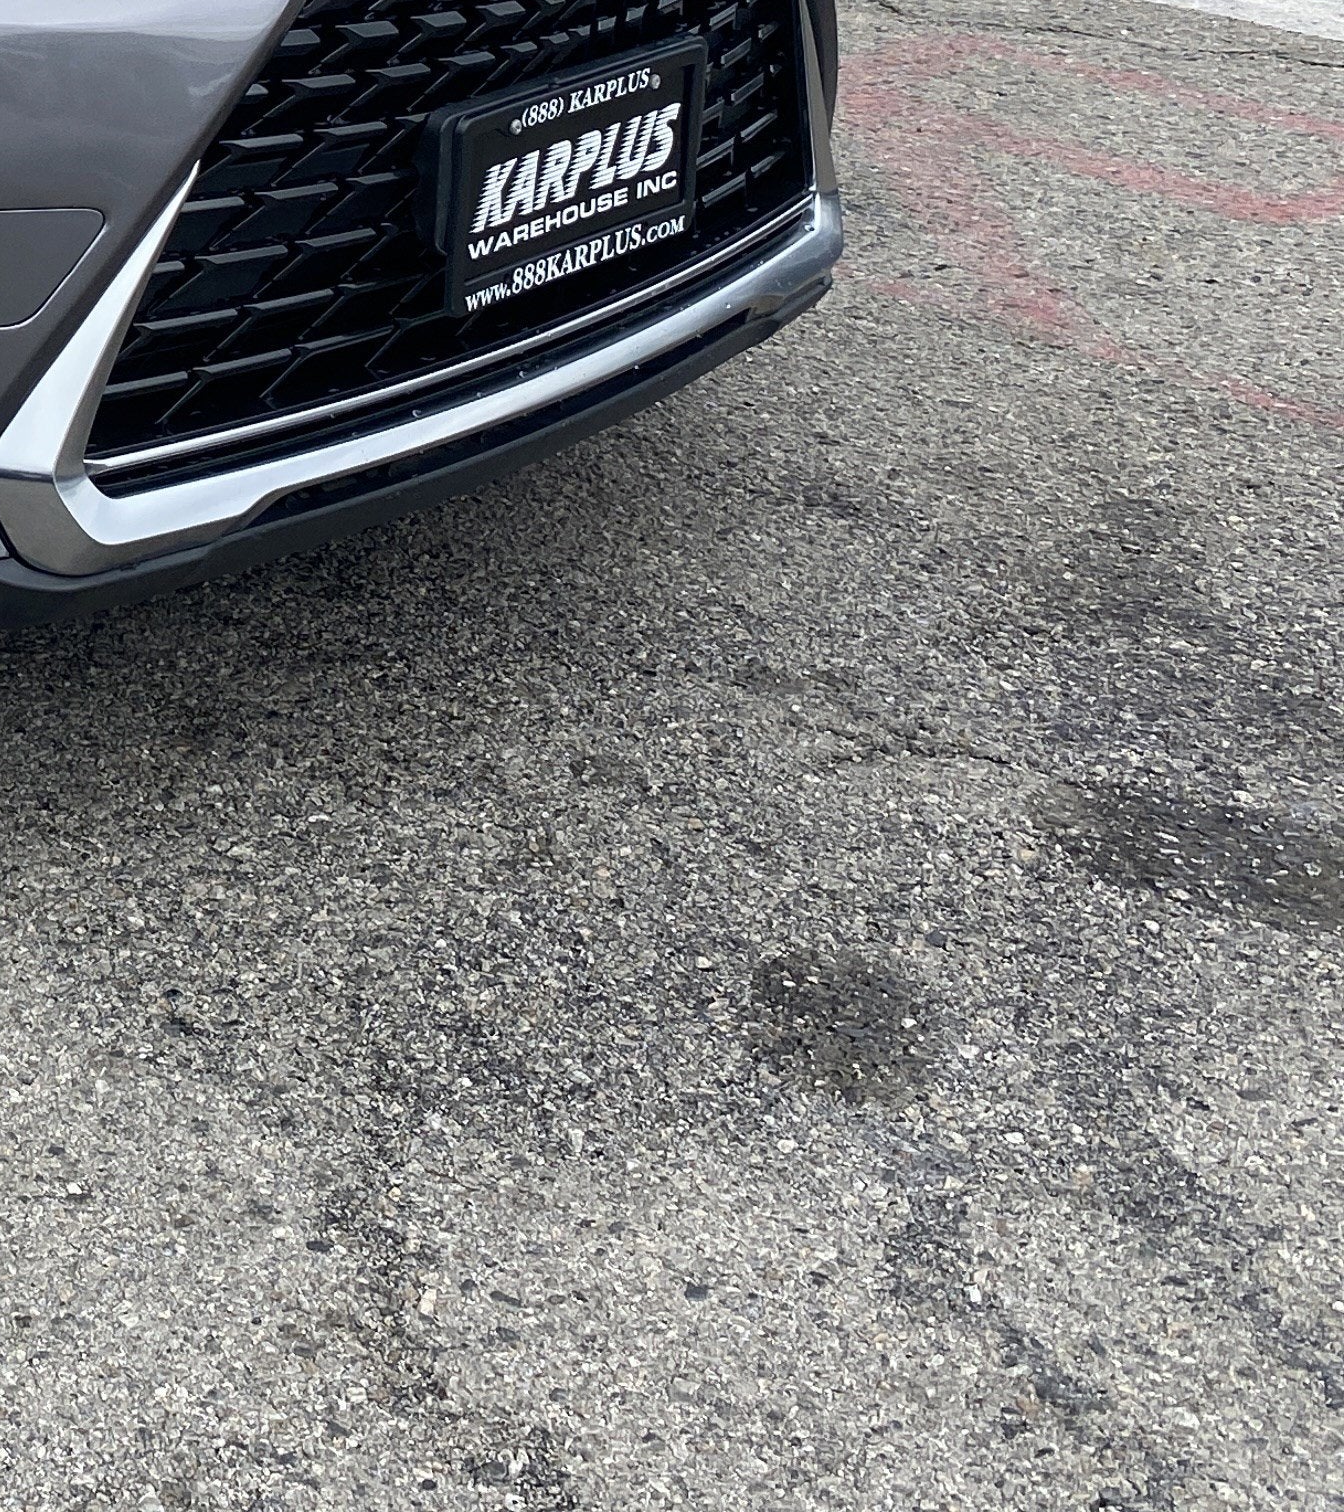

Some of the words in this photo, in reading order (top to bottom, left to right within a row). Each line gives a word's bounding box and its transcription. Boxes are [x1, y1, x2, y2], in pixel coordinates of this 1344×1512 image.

[521, 96, 565, 128] (888)
[568, 67, 651, 113] KARPLUS
[469, 102, 681, 234] KARPLUS
[469, 187, 628, 260] WAREHOUSE
[636, 170, 678, 199] INC
